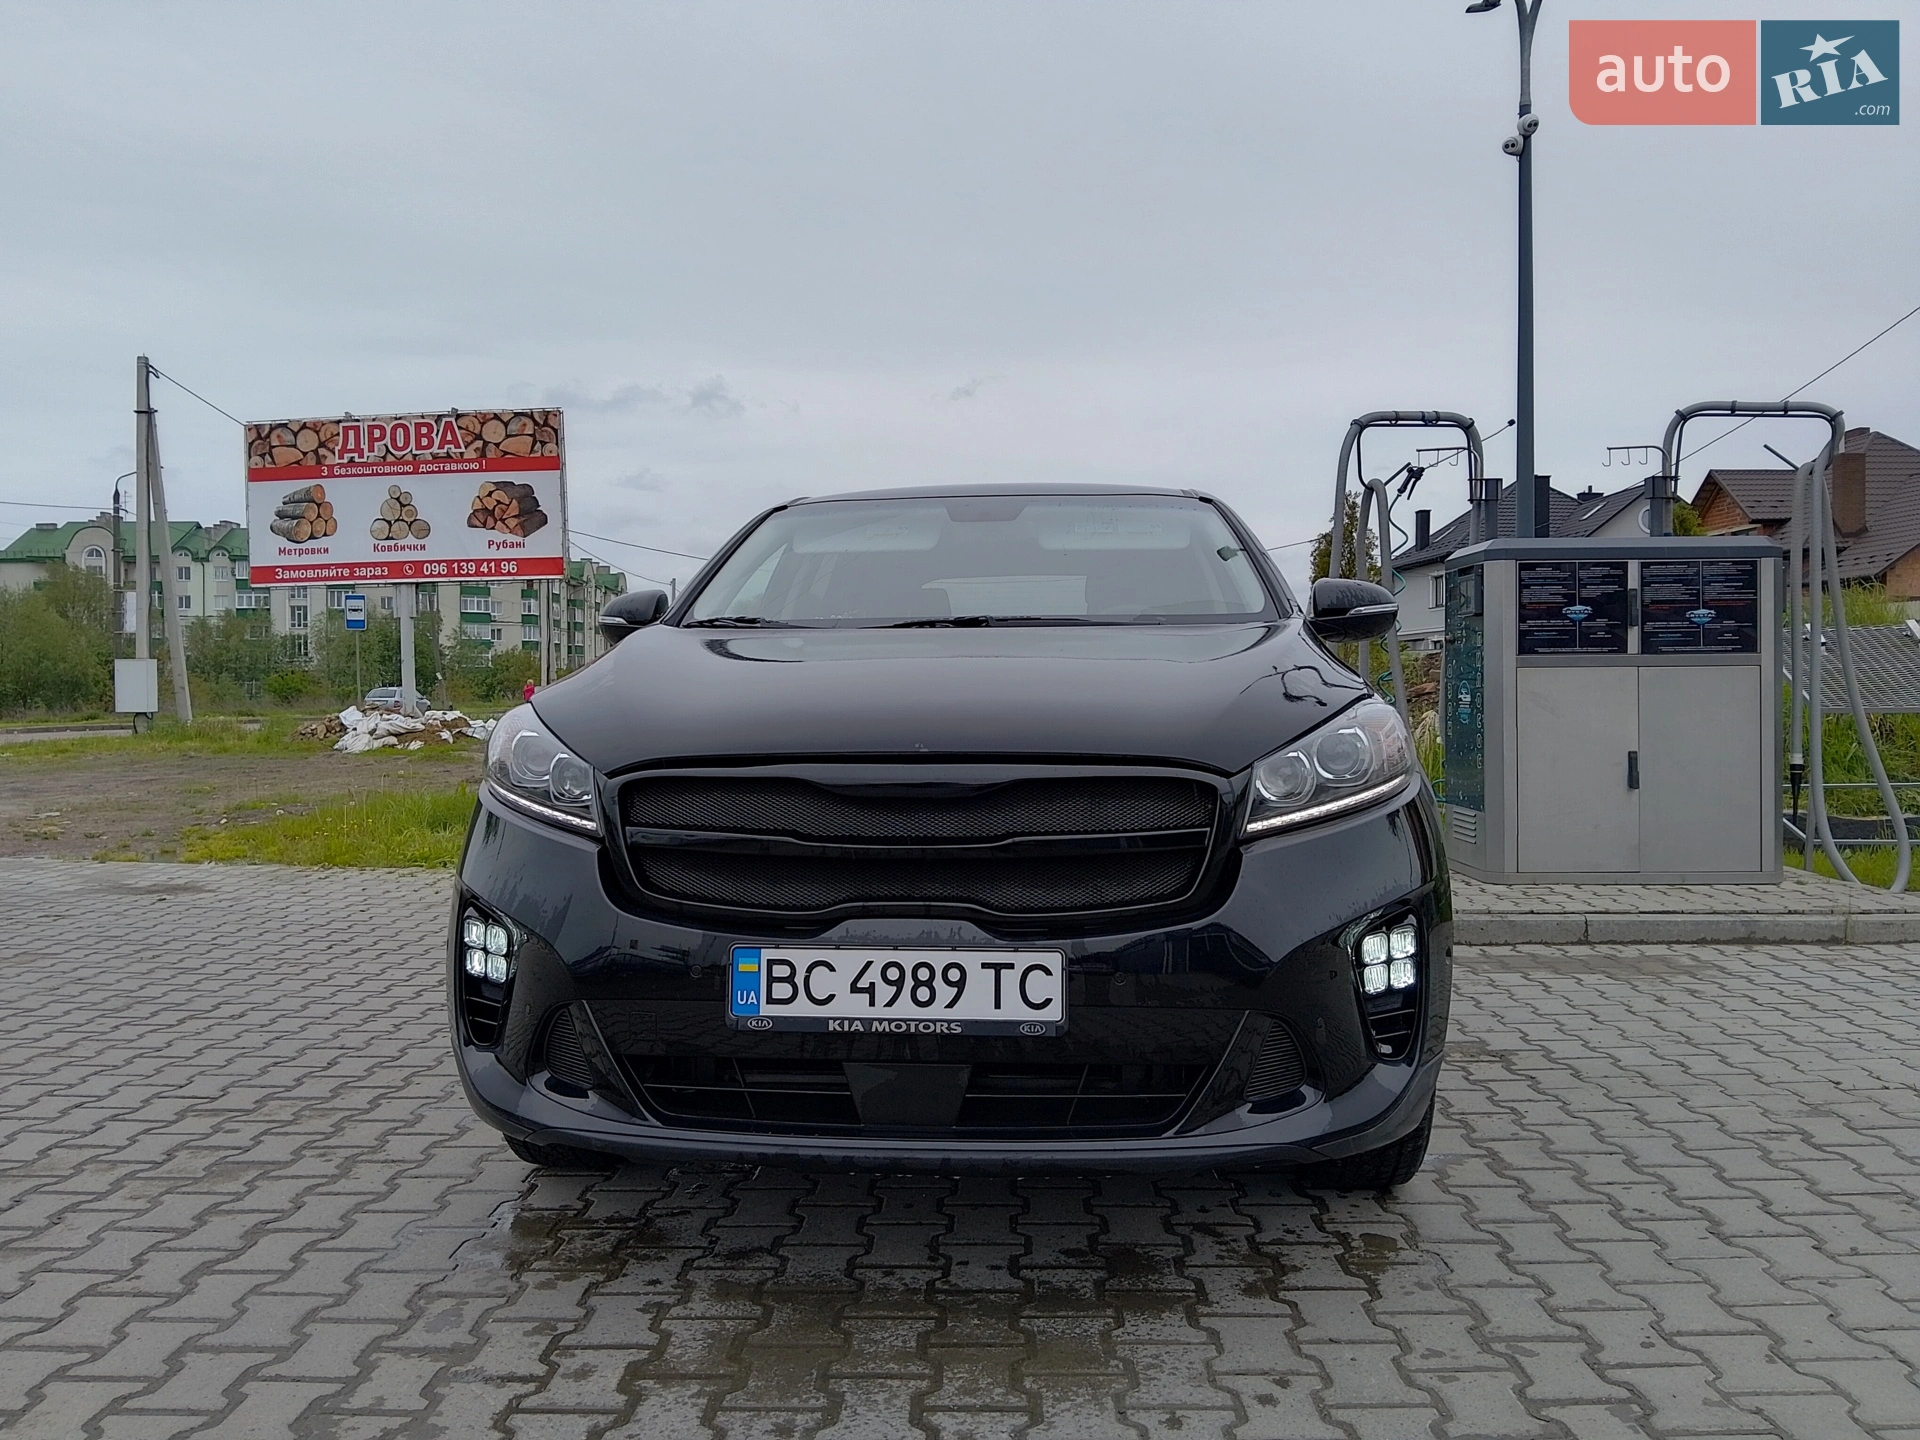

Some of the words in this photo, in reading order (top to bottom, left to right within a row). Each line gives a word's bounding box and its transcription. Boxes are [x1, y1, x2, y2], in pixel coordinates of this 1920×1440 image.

[337, 418, 465, 461] ДРОВА
[333, 463, 413, 475] безкоштовною
[419, 461, 479, 474] доставкою
[278, 546, 329, 557] Метровки
[373, 542, 427, 553] Ковбички
[487, 539, 526, 550] Рубані
[275, 567, 350, 579] Замовляйте
[353, 566, 389, 577] зараз
[423, 562, 448, 575] 096
[451, 562, 476, 575] 139
[480, 561, 498, 574] 41
[500, 561, 518, 574] 96
[765, 958, 838, 1006] BC
[850, 960, 968, 1009] 4989
[980, 962, 1054, 1010] TC
[737, 990, 758, 1006] UA
[751, 1018, 770, 1028] KIA
[828, 1019, 865, 1032] KIA
[871, 1020, 962, 1034] MOTORS
[1023, 1023, 1043, 1033] KIA
